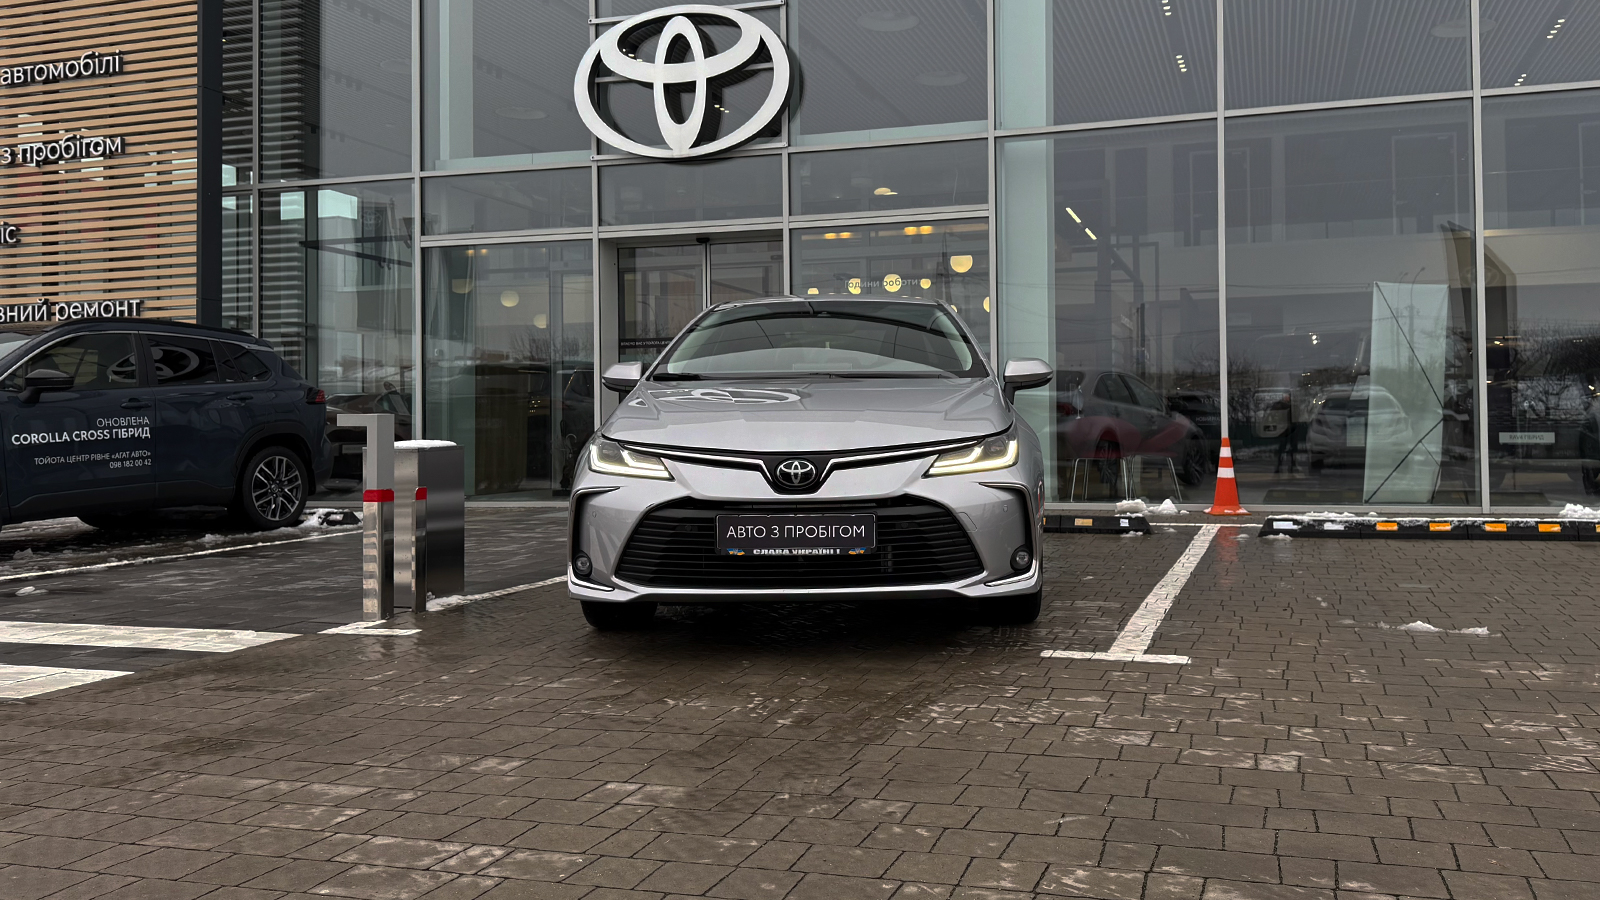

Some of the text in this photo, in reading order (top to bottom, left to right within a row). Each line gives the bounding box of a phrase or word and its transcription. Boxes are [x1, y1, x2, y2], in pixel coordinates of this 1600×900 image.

[0, 49, 120, 85] автомобілі
[1, 133, 122, 167] з пробігом
[55, 299, 141, 322] ремонт
[96, 416, 150, 428] ОНОВЛЕНА
[11, 427, 151, 445] COROLLA CROSS ГІБРИД
[34, 450, 151, 466] ТОЙОТА ЦЕНТР РІВНЕ «АГАТ АВТО»
[109, 461, 122, 469] 098
[123, 460, 134, 468] 182
[726, 525, 865, 538] АВТО З ПРОБІГОМ
